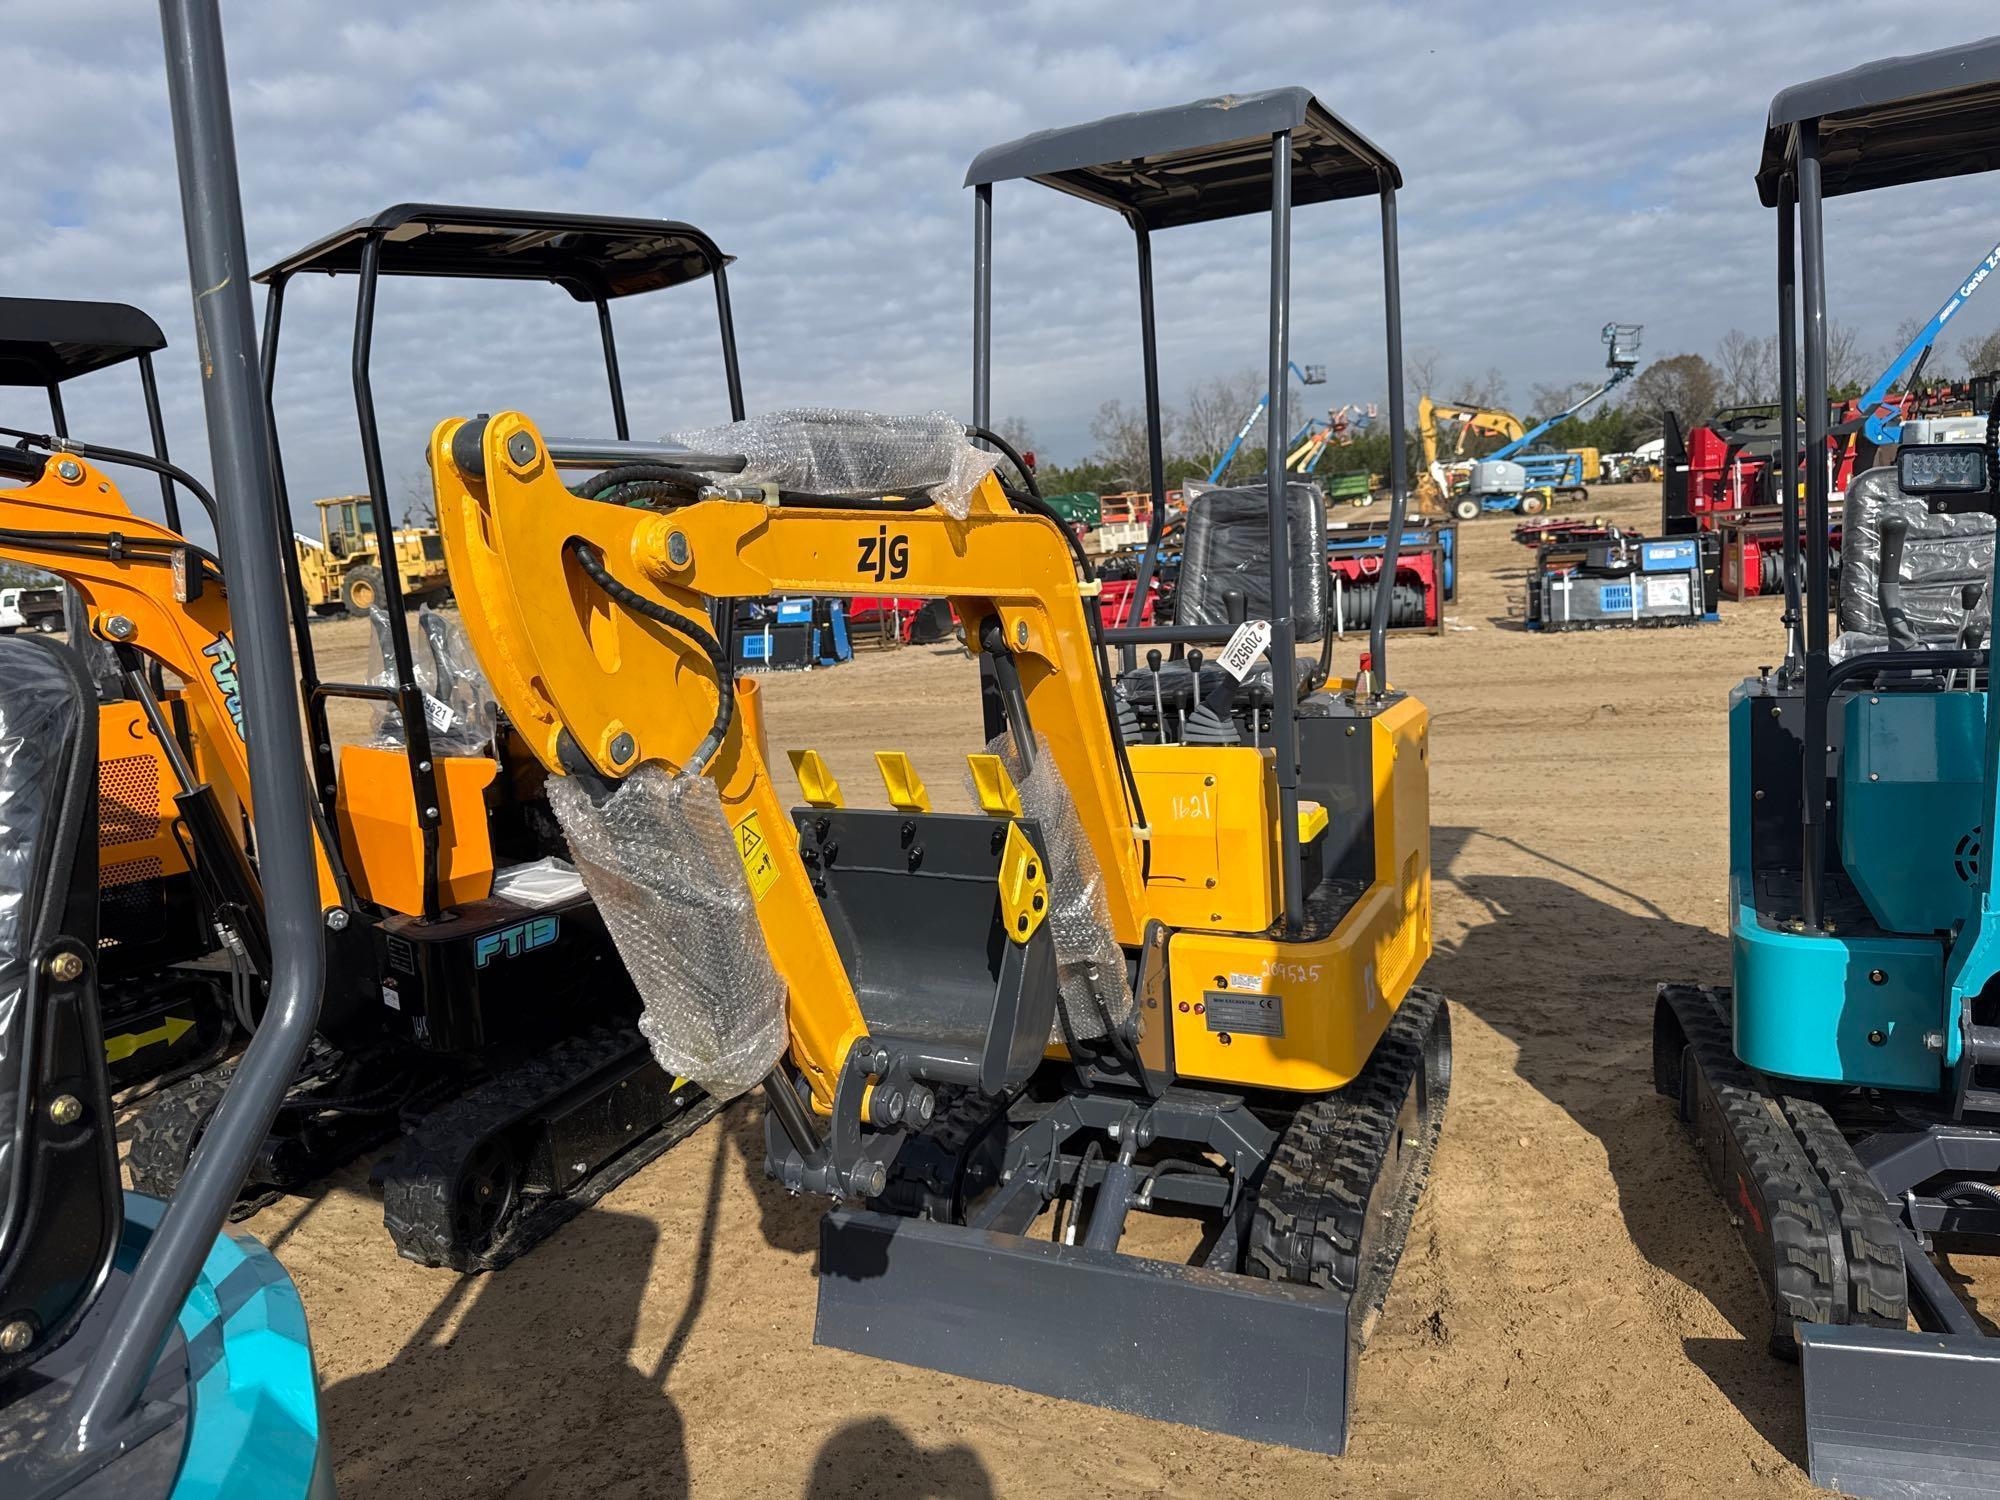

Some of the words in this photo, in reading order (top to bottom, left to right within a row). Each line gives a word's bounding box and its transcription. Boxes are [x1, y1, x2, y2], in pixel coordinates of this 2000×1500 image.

[1960, 269, 1989, 297] Genie
[857, 524, 909, 583] zjg
[1230, 631, 1263, 672] 209525
[1261, 959, 1323, 984] 209525
